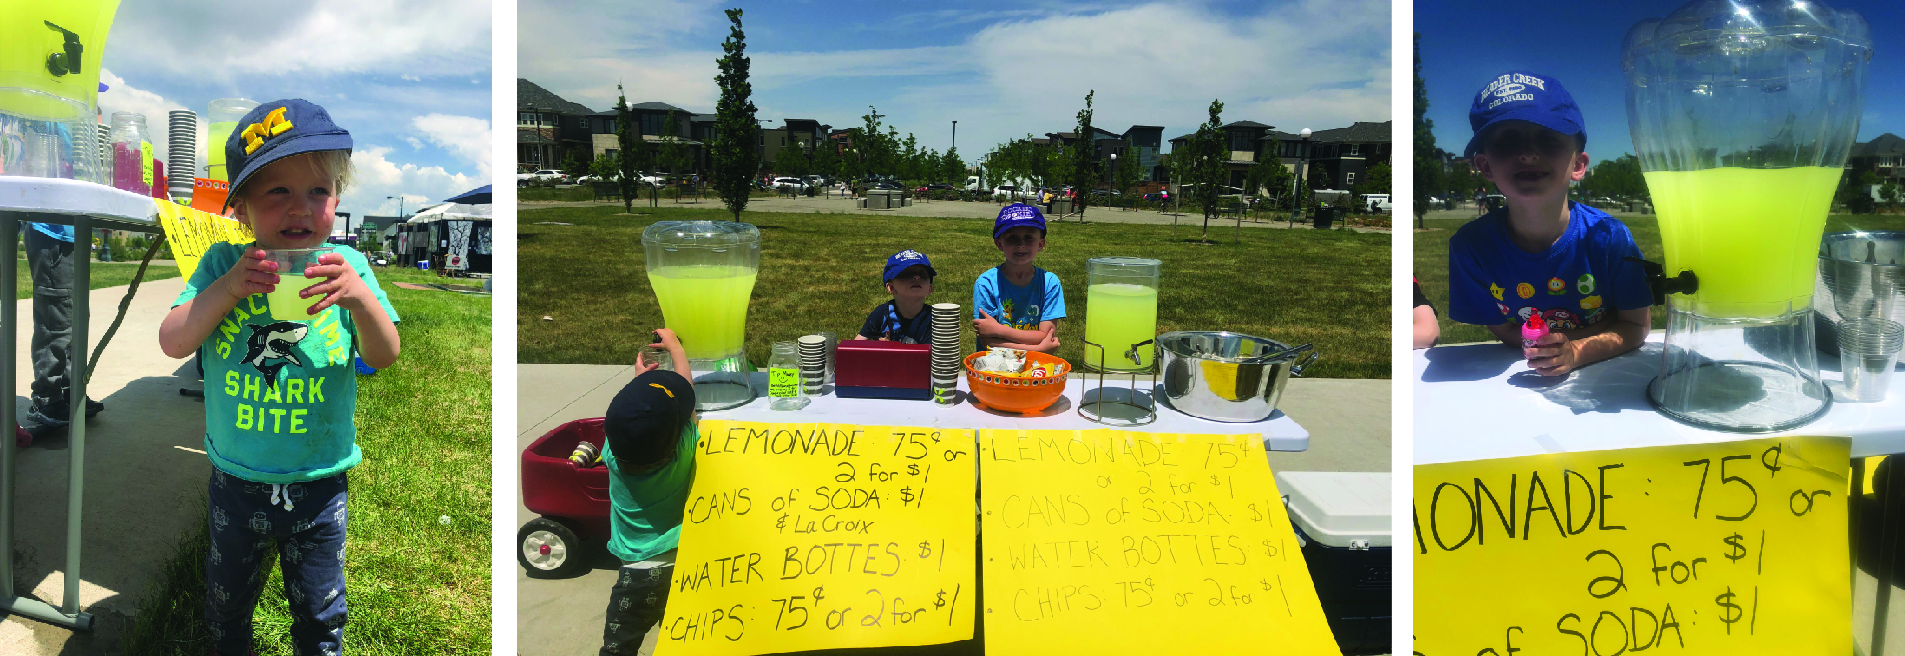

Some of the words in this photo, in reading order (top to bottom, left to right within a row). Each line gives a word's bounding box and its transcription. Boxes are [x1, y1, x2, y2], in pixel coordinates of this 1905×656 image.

[1513, 73, 1545, 91] CREEK
[1489, 94, 1534, 109] COLORADO
[241, 106, 293, 156] M
[215, 292, 268, 360] SNAC
[313, 309, 347, 367] IME
[225, 370, 325, 404] SHARK
[236, 403, 308, 434] BITE
[892, 431, 941, 460] 75¢
[944, 450, 966, 462] or
[835, 462, 856, 482] 2
[869, 463, 898, 482] for
[907, 463, 931, 483] $1
[1096, 475, 1111, 488] or
[1137, 471, 1153, 494] 2
[1169, 473, 1196, 495] for
[1210, 474, 1234, 499] $1
[1683, 443, 1782, 522] 75¢
[1789, 489, 1831, 517] or
[690, 488, 751, 524] CANS
[771, 489, 799, 512] of
[900, 486, 924, 508] $1
[1002, 494, 1090, 529] CANS
[1106, 497, 1130, 524] of
[1248, 500, 1273, 528] $1
[680, 552, 764, 593] WATER
[918, 539, 945, 572] $1
[1009, 540, 1108, 570] WATER
[1262, 539, 1287, 561] $1
[1585, 549, 1627, 599] 2
[1651, 542, 1707, 586] for
[1723, 530, 1764, 575] $1
[771, 586, 826, 631] 75¢
[826, 607, 852, 630] or
[861, 589, 884, 627] 2
[891, 598, 926, 625] for
[933, 583, 960, 626] $1
[1115, 576, 1155, 607] 75¢
[1175, 592, 1194, 607] or
[1204, 578, 1226, 607] 2
[1230, 586, 1254, 606] for
[1260, 574, 1292, 617] $1
[1715, 585, 1758, 635] $1
